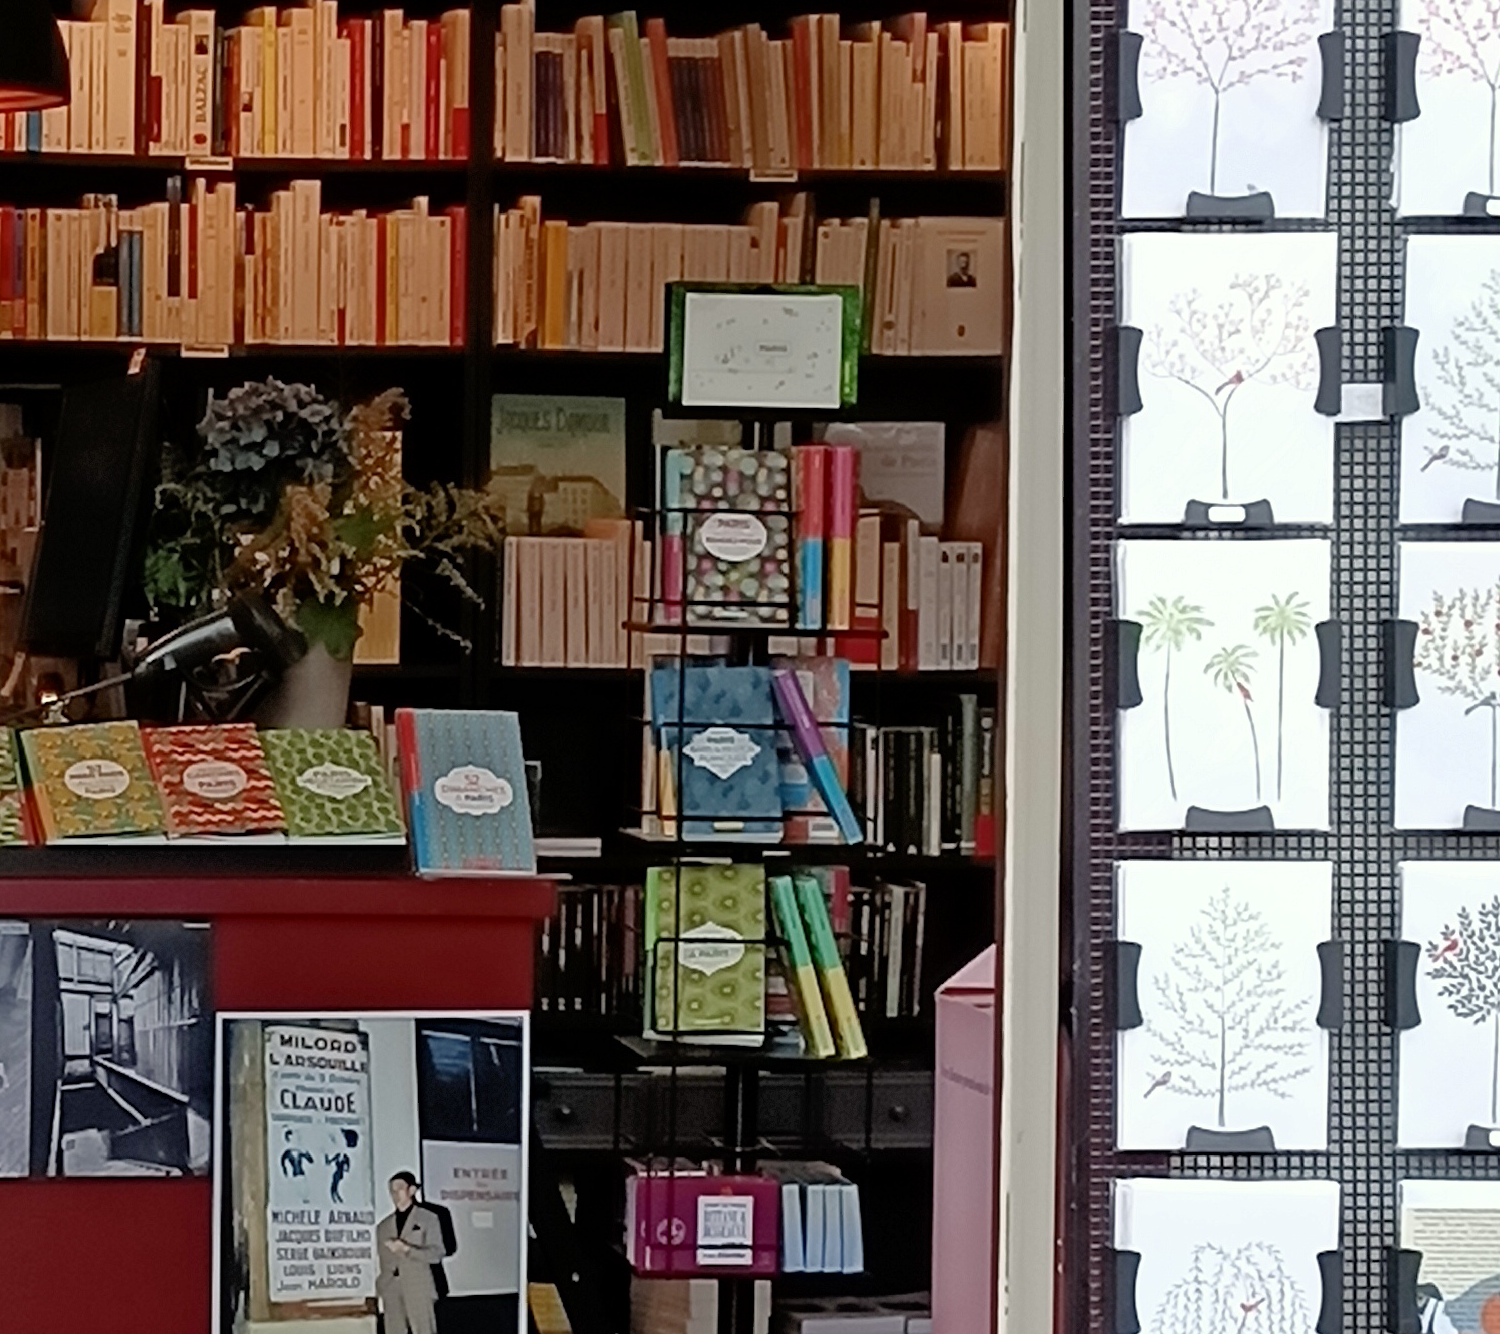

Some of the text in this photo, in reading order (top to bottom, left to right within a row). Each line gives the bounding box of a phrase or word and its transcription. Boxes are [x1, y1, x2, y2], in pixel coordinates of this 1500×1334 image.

[194, 66, 210, 124] BALZAC
[464, 774, 480, 786] 52
[278, 1033, 358, 1055] MILORD
